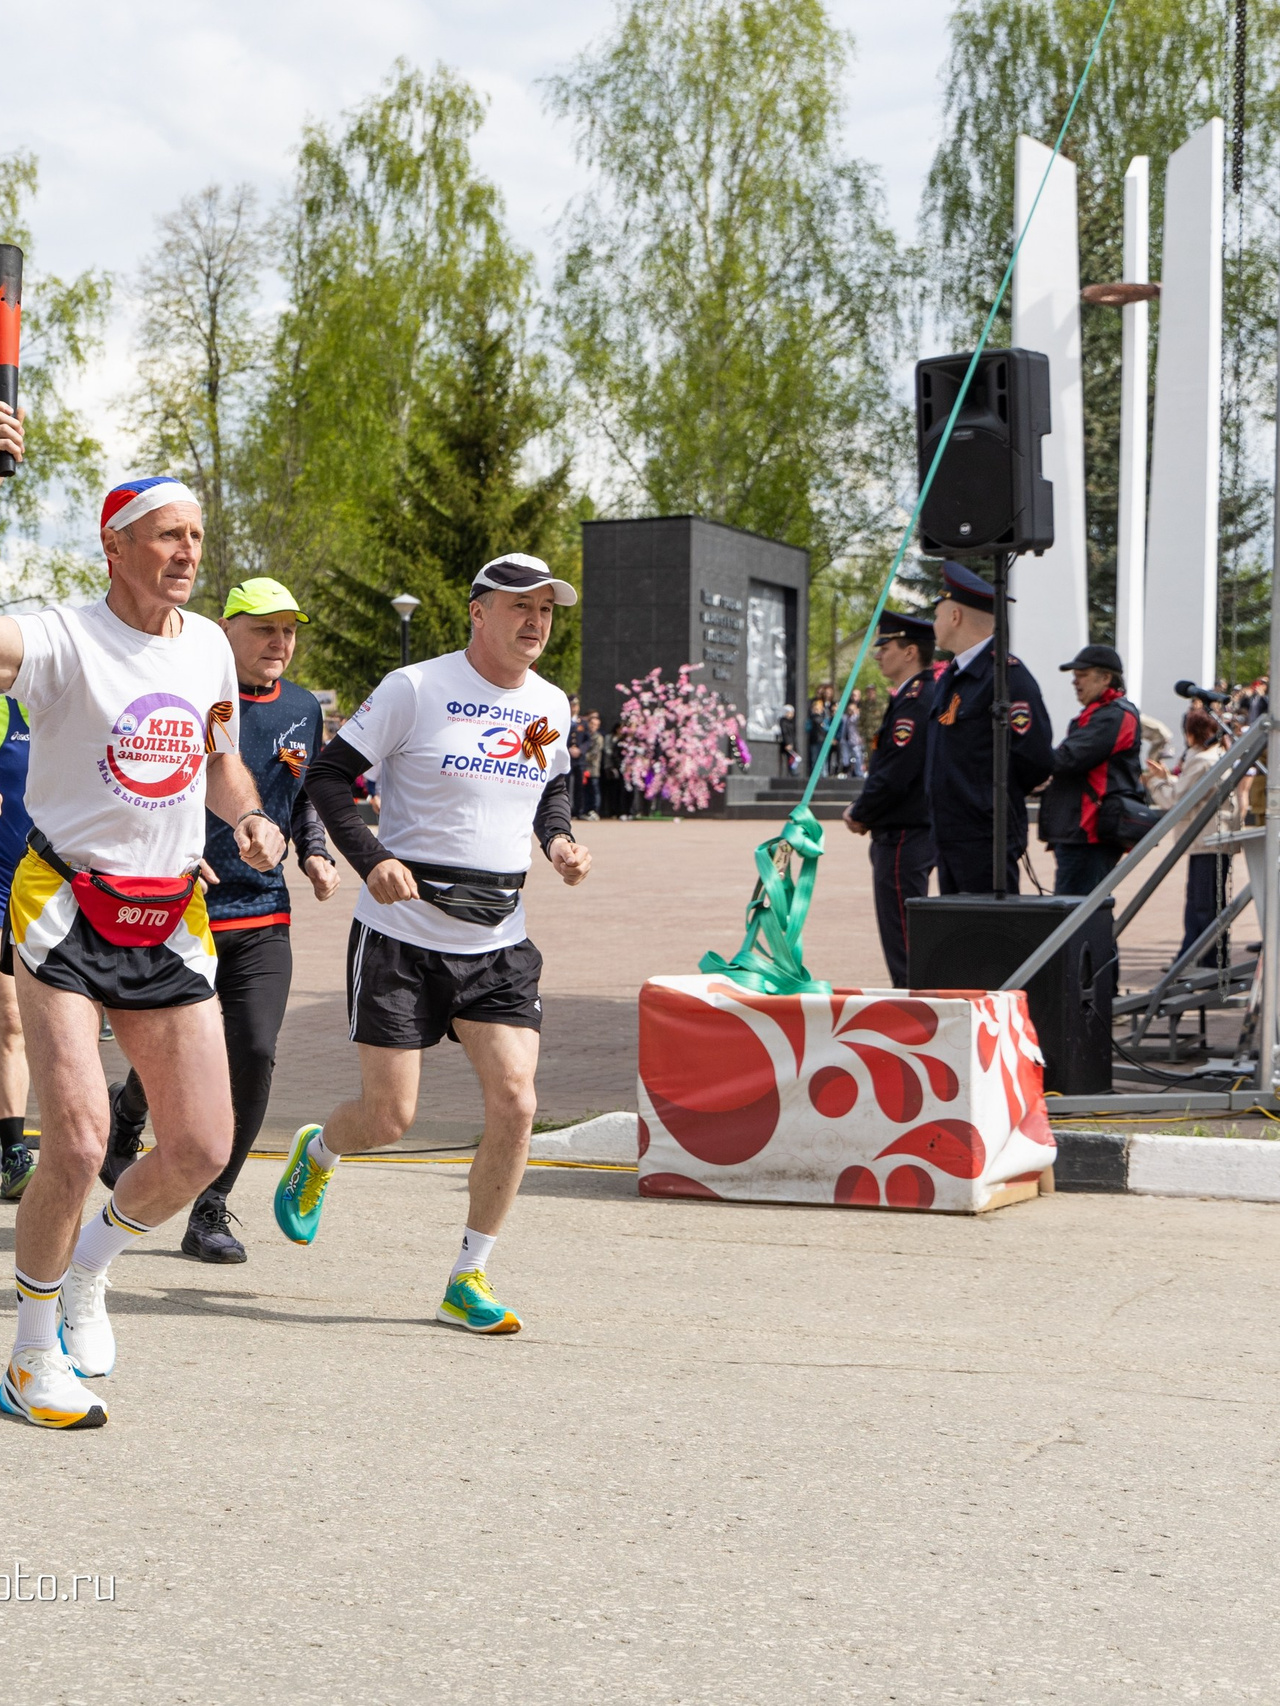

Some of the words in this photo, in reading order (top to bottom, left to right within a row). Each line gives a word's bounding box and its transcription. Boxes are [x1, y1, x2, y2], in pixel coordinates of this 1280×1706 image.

[148, 718, 194, 738] КЛБ
[119, 736, 201, 753] «ОЛЕНЬ»
[289, 740, 306, 750] TEAM
[117, 750, 182, 765] ЗАВОЛЖЬЕ
[440, 770, 504, 784] manufacturing
[441, 754, 548, 783] FORENERGO
[97, 758, 112, 785] Мы
[113, 786, 187, 811] выбираем
[282, 1160, 305, 1201] HOKA
